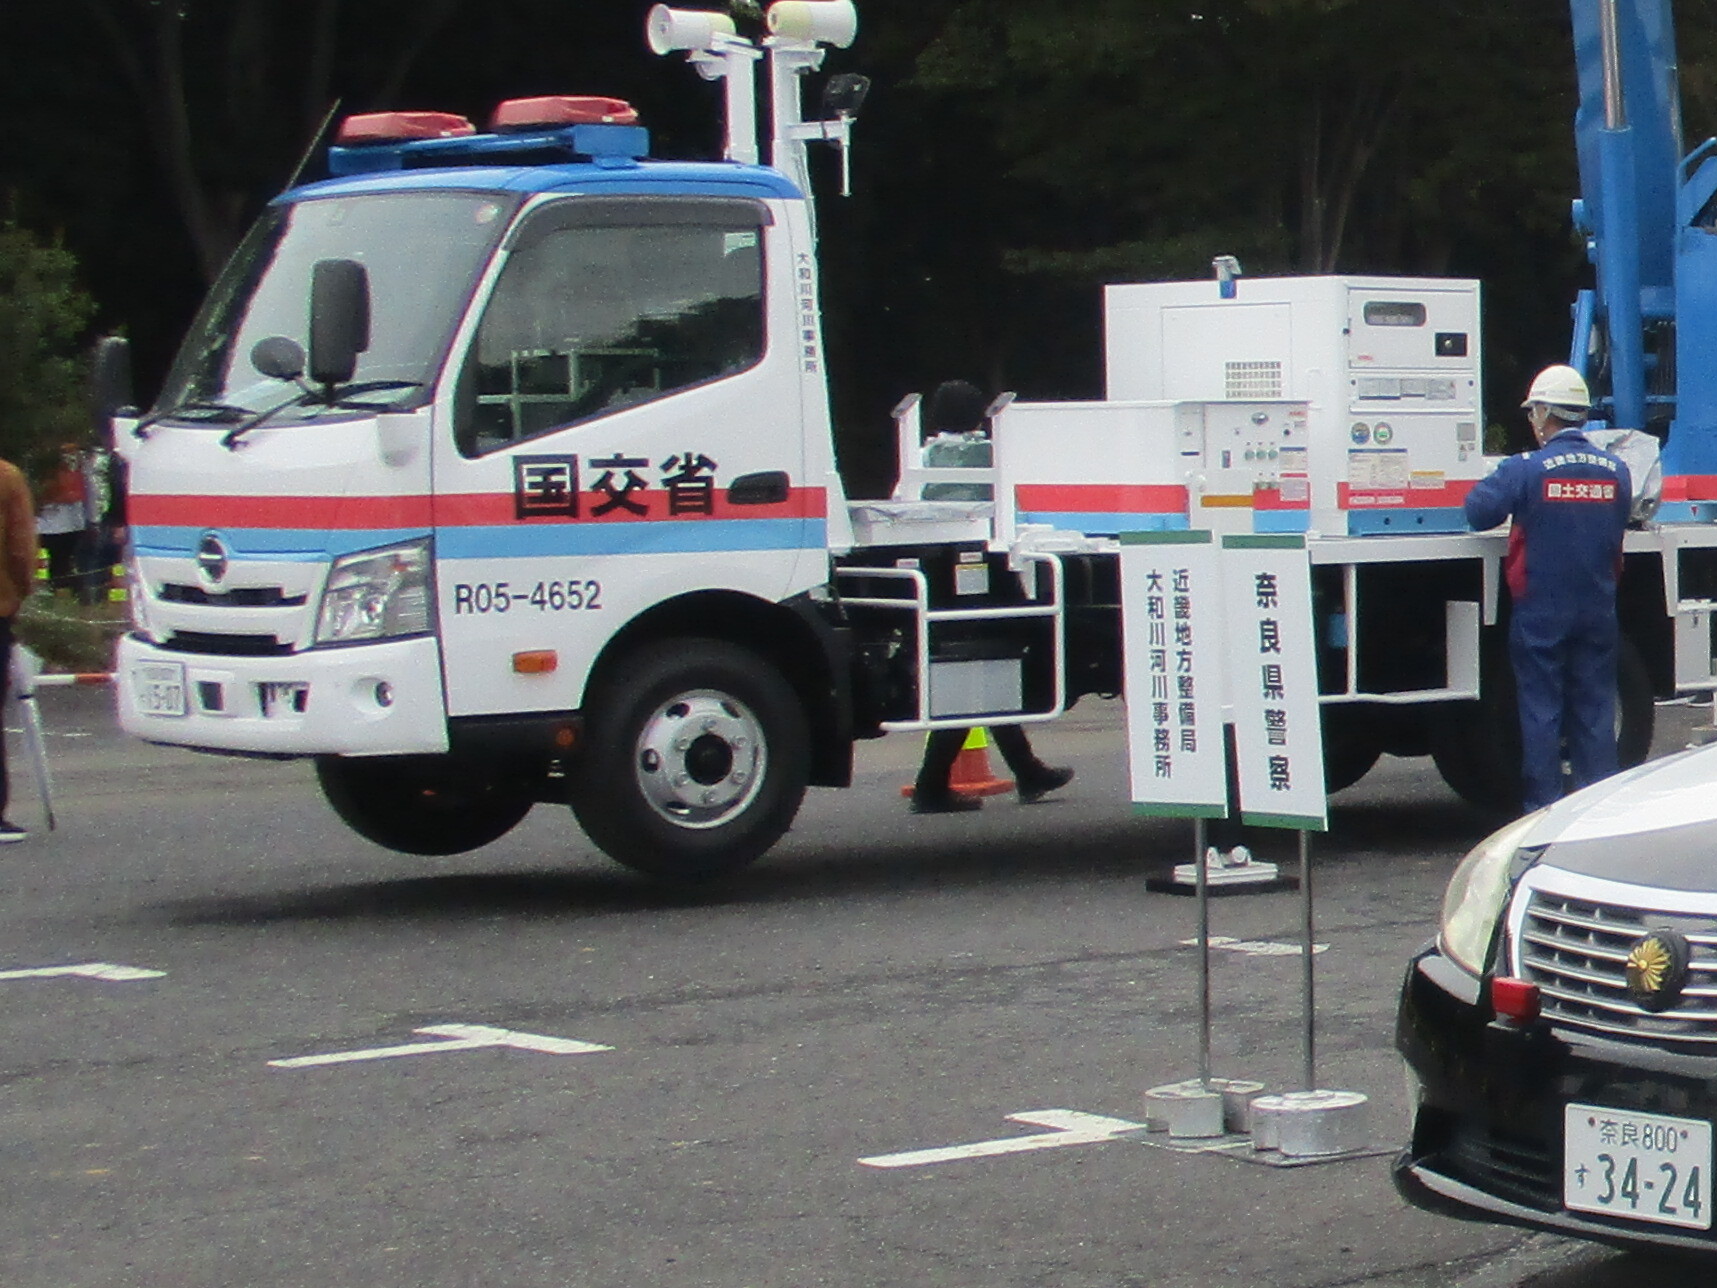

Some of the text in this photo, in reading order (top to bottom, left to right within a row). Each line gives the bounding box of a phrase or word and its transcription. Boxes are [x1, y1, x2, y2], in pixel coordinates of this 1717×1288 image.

[512, 451, 719, 520] 国交省
[454, 579, 602, 614] R05-4652
[1145, 568, 1172, 779] 大和川河川事務所
[1172, 568, 1197, 753] 近畿地方整備局
[1254, 571, 1292, 791] 奈良県警察
[1597, 1153, 1702, 1219] 34-24
